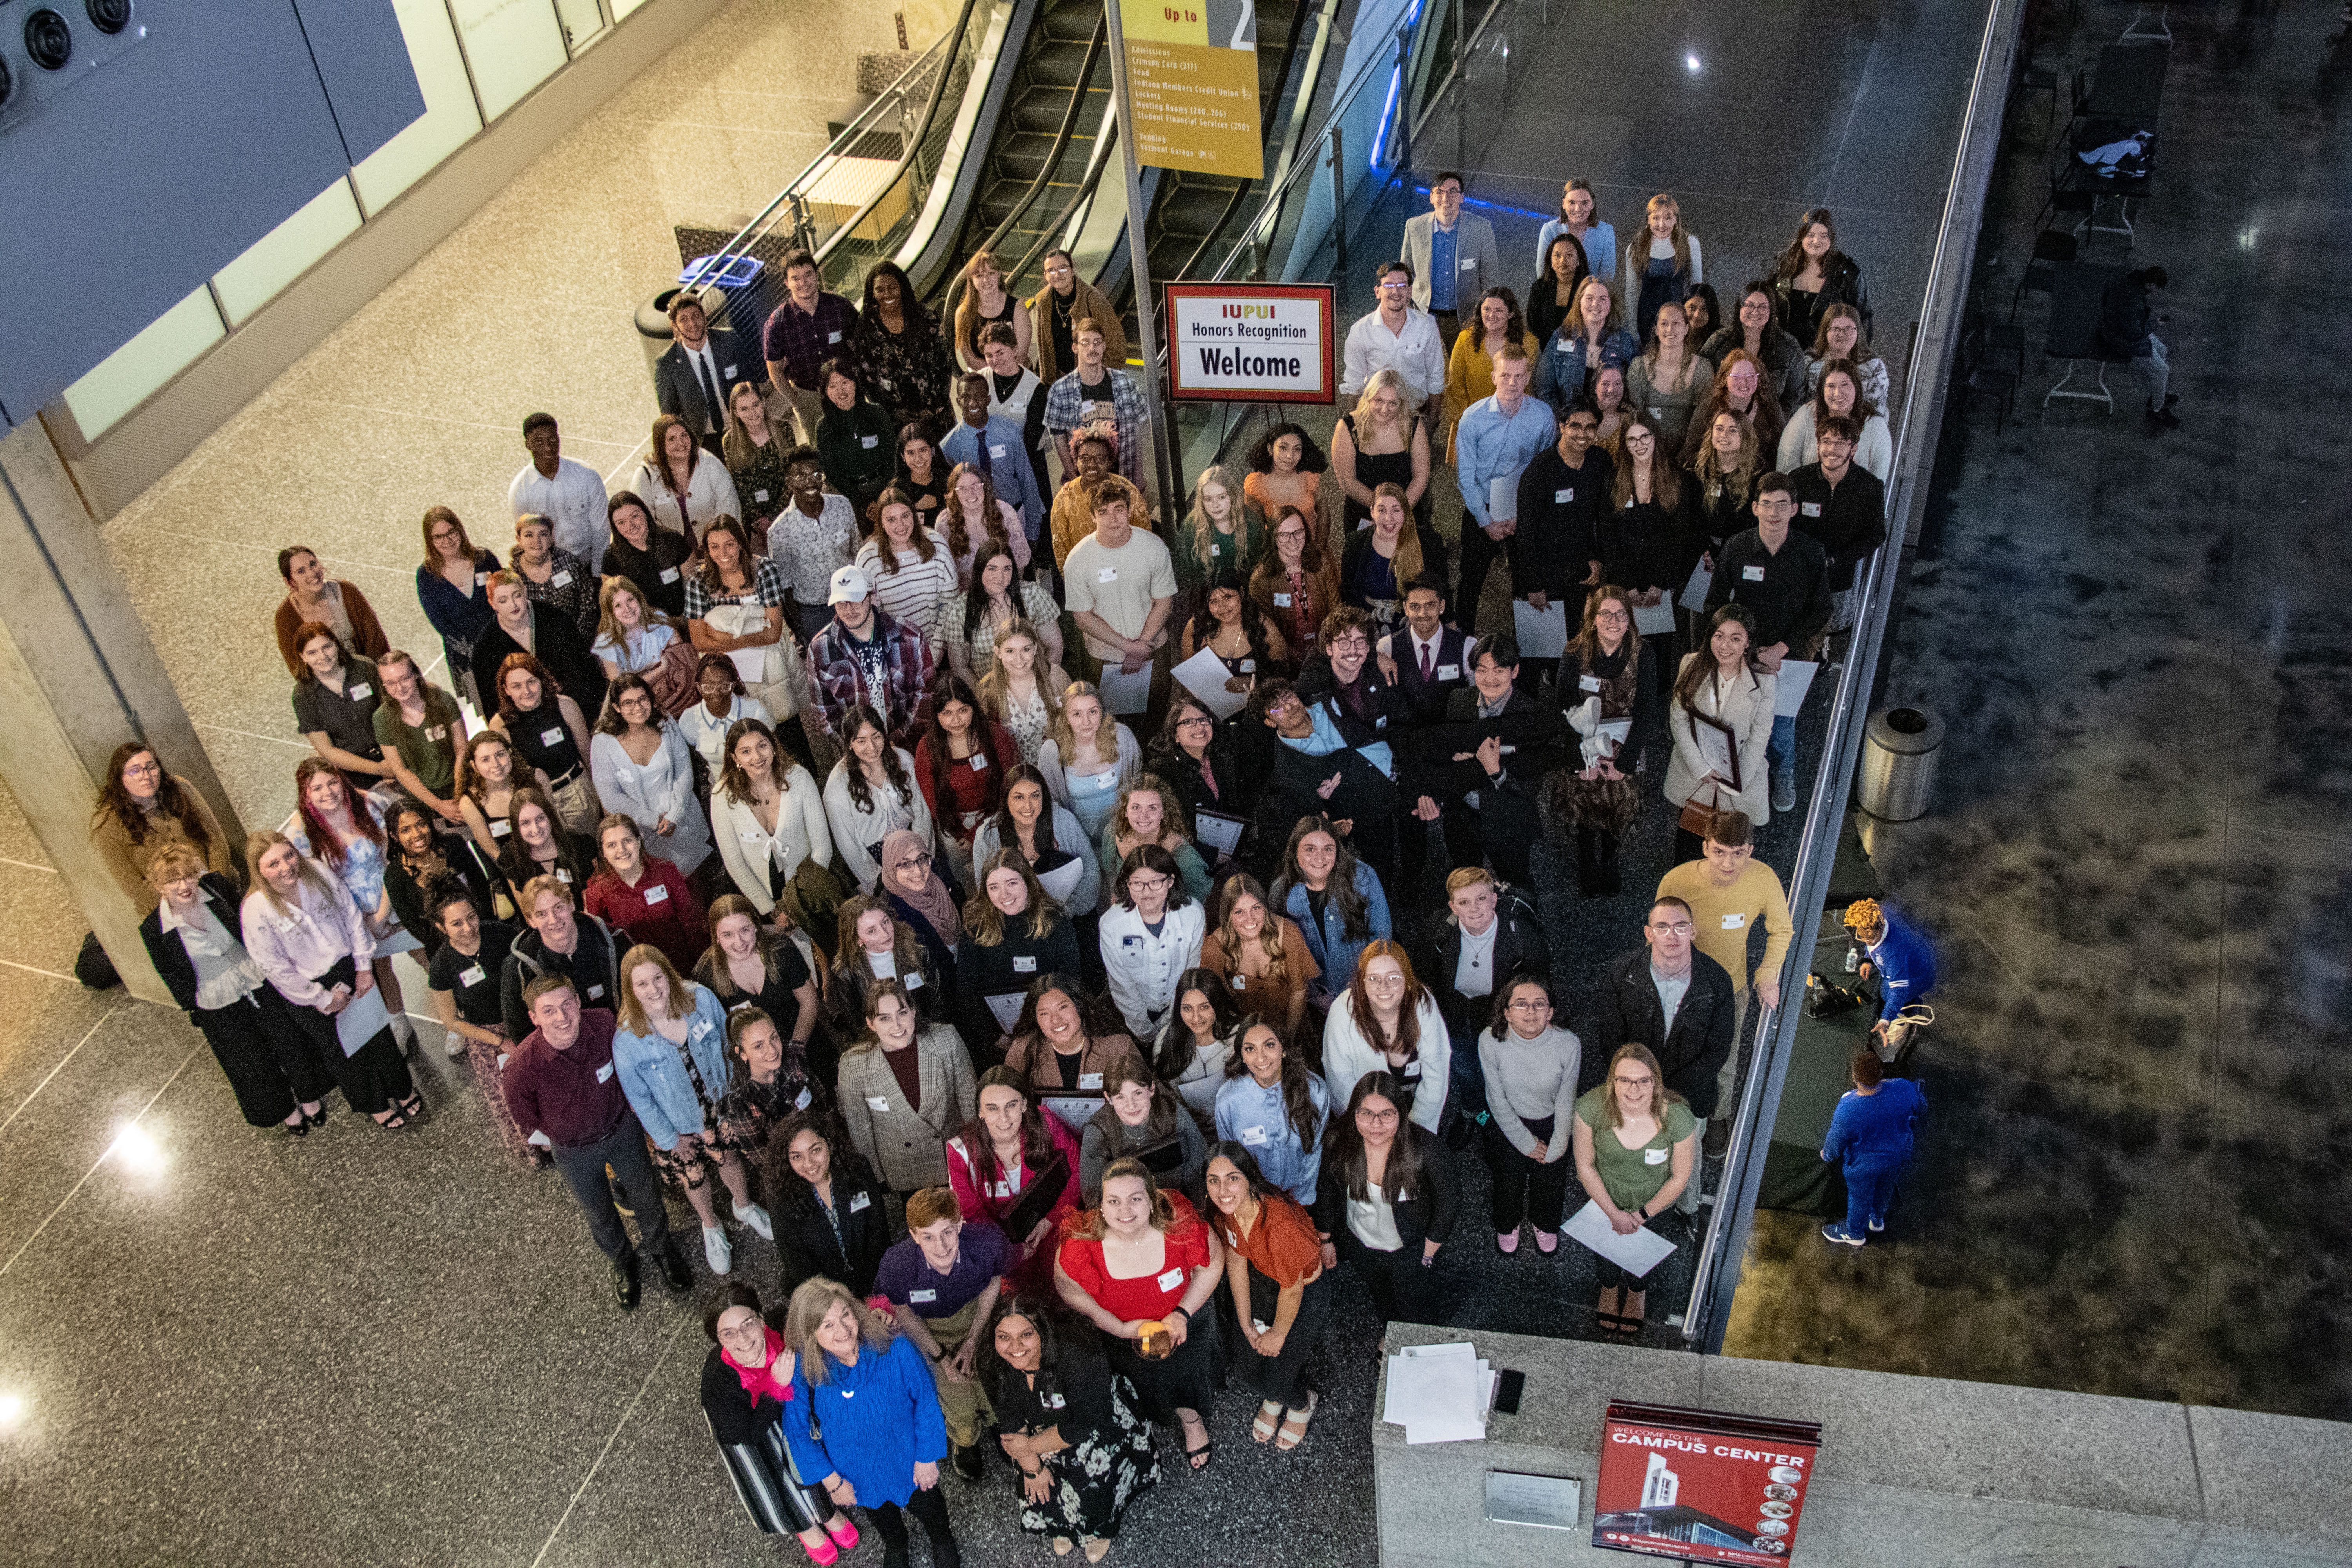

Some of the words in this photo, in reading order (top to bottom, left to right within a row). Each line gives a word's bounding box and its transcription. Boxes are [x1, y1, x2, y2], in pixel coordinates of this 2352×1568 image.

[1165, 7, 1179, 22] Up
[1185, 9, 1197, 22] to
[1230, 0, 1255, 51] 2
[1131, 45, 1171, 57] Admissions
[1132, 56, 1160, 66] Crimson
[1162, 60, 1177, 69] Card
[1133, 68, 1150, 77] Food
[1134, 78, 1160, 89] Indiana
[1162, 82, 1192, 93] Members
[1195, 85, 1216, 95] Credit
[1218, 88, 1239, 97] Union
[1136, 91, 1161, 100] Lockers
[1136, 100, 1163, 112] Meeting
[1165, 104, 1188, 114] Rooms
[1137, 111, 1163, 121] Student
[1165, 114, 1197, 125] Financial
[1199, 118, 1228, 129] Services
[1139, 133, 1166, 144] Vending
[1140, 144, 1168, 154] Vermont
[1170, 147, 1194, 157] Garage
[1222, 304, 1276, 319] IUPUI
[1192, 322, 1234, 337] Honors
[1238, 323, 1307, 341] Recognition
[1200, 346, 1301, 377] Welcome
[1613, 1426, 1665, 1439] WELCOME
[1612, 1432, 1708, 1454] CAMPUS
[1713, 1446, 1805, 1468] CENTER
